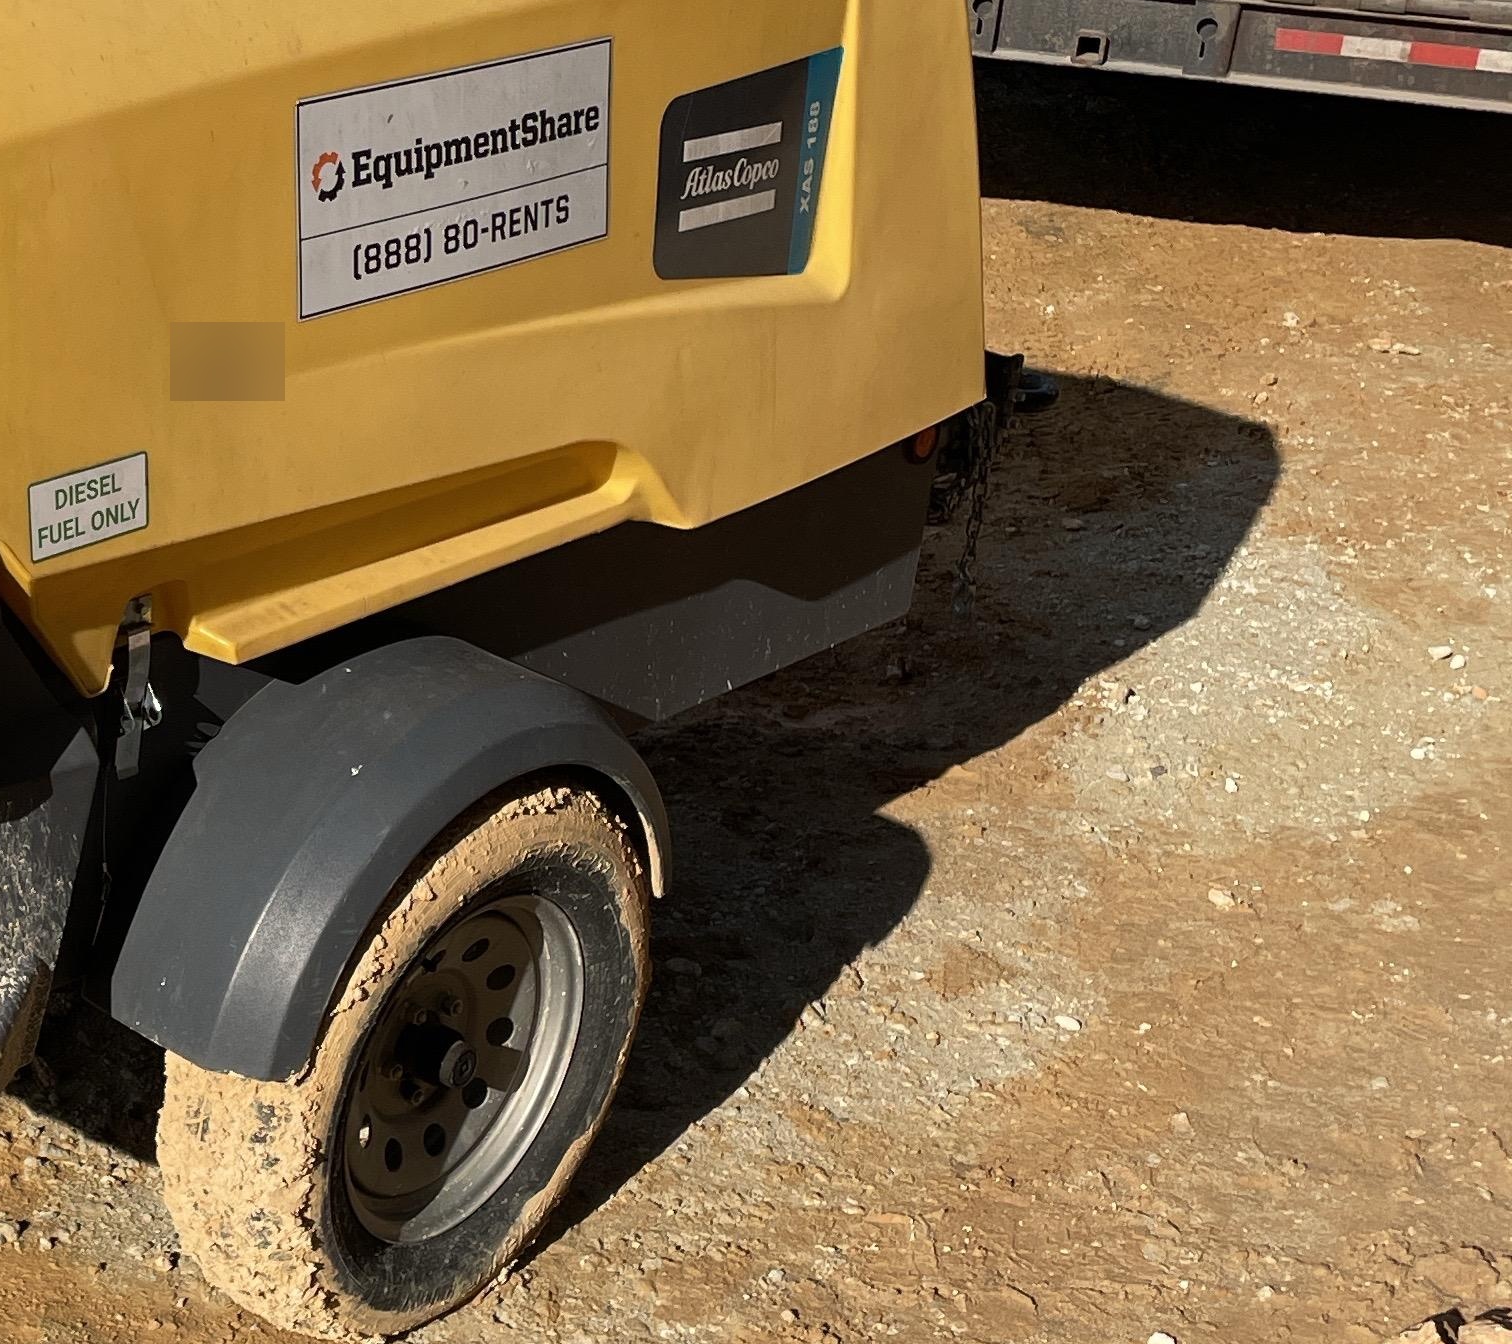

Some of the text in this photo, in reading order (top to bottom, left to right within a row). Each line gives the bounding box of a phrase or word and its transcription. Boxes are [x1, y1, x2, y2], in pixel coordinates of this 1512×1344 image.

[351, 105, 600, 190] EquipmentShare
[800, 101, 821, 215] XAS 188
[353, 194, 570, 280] (888) 80-RENTS
[37, 498, 140, 548] FUEL ONLY
[54, 473, 122, 511] DIESEL
